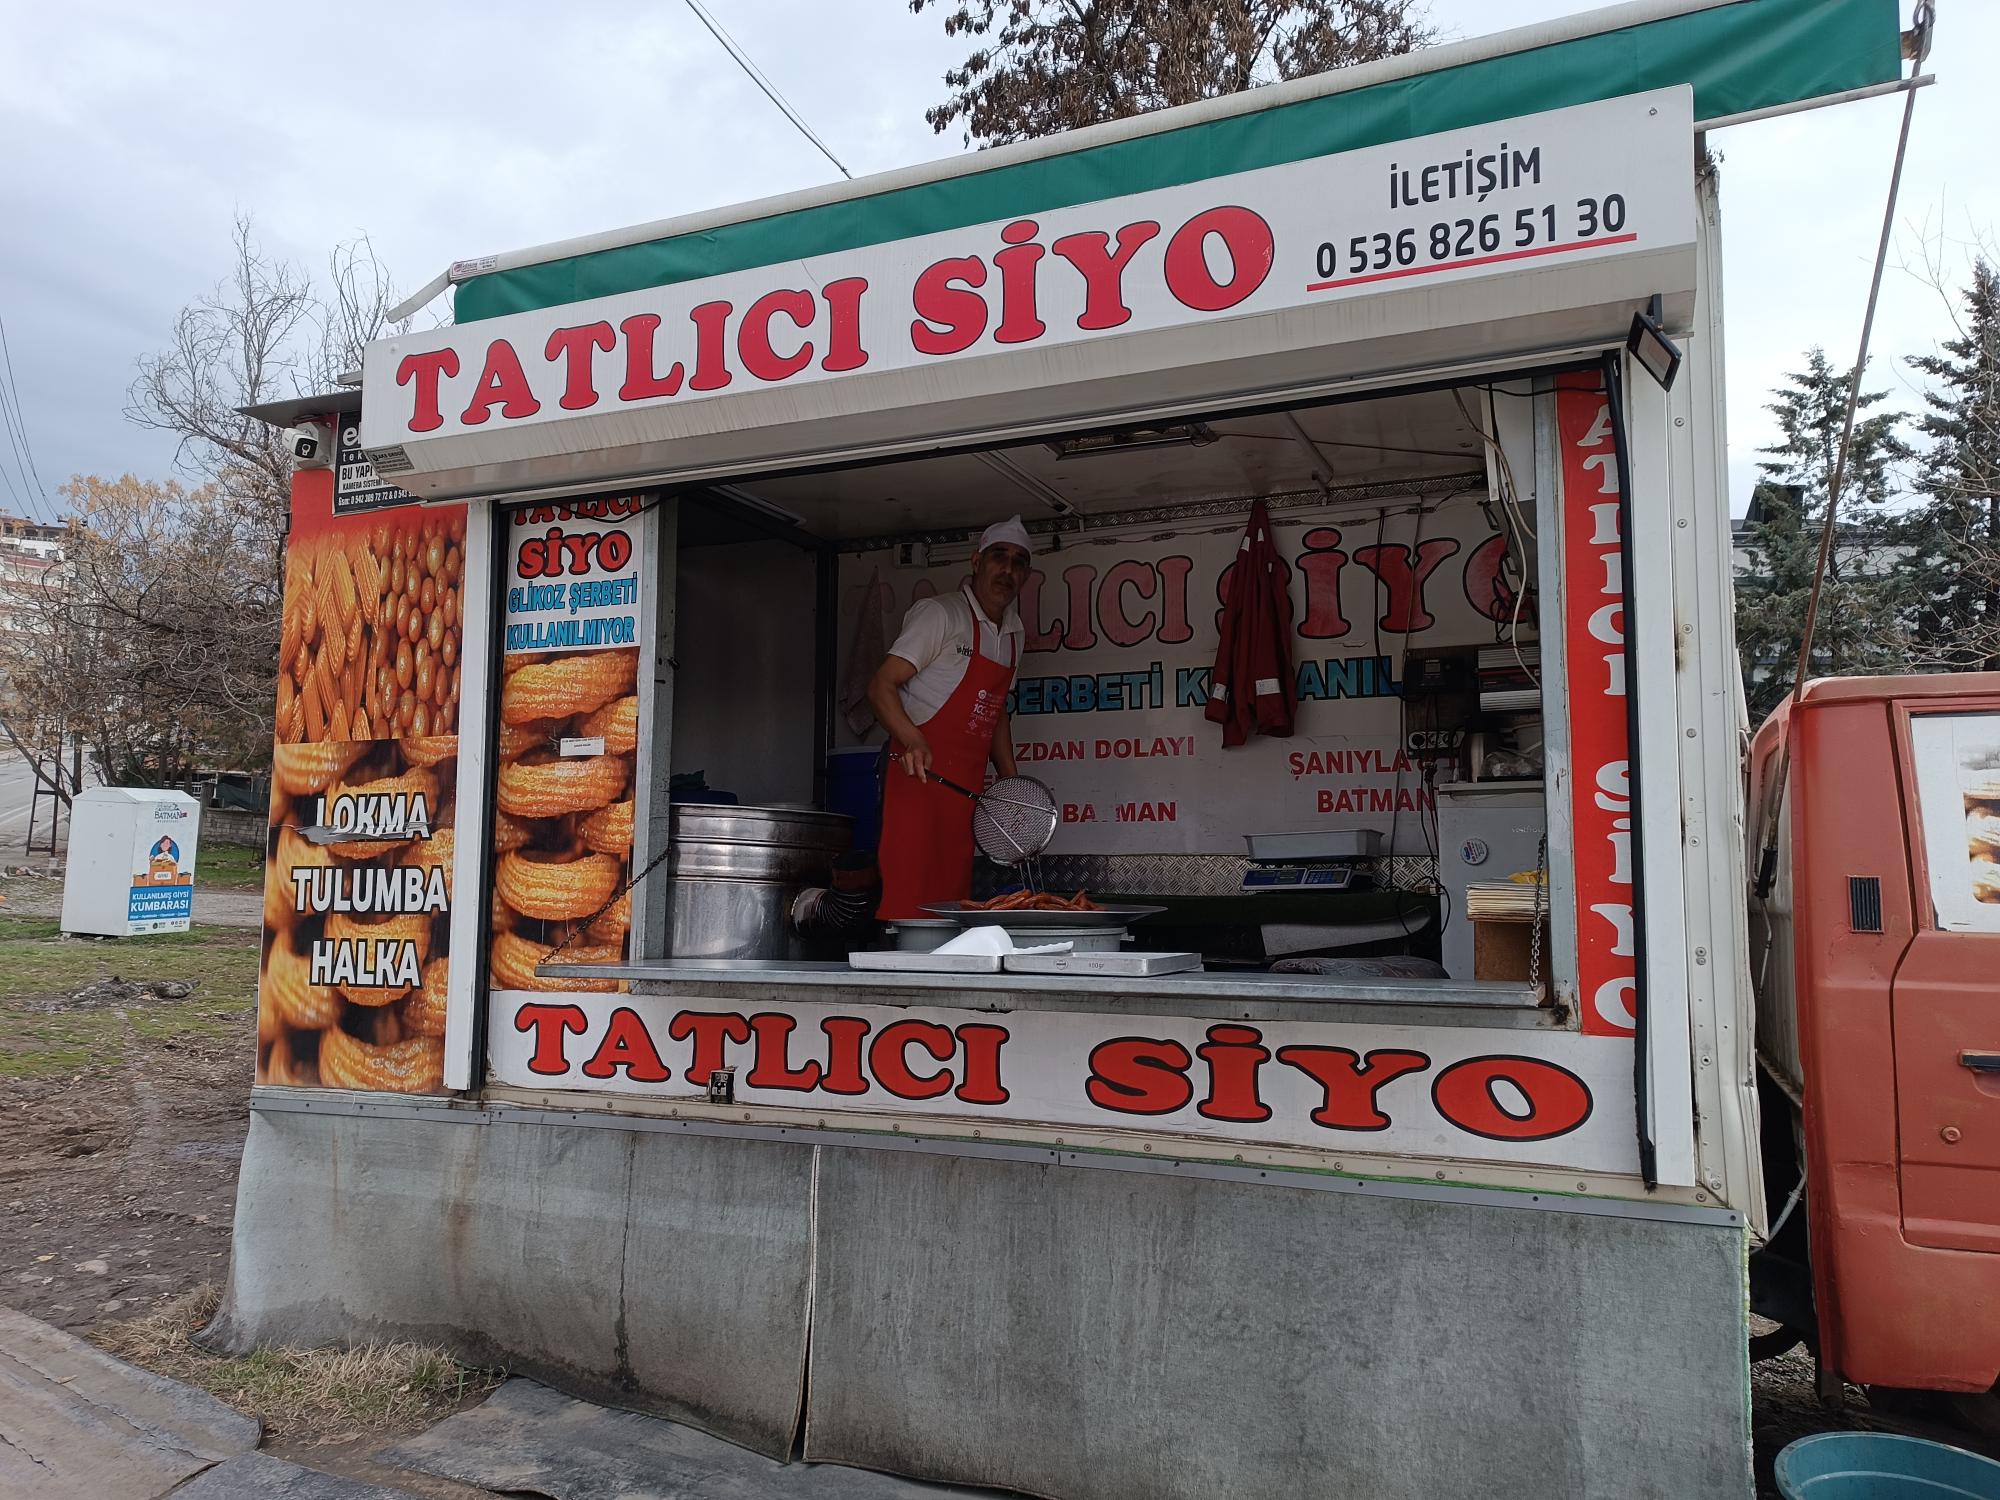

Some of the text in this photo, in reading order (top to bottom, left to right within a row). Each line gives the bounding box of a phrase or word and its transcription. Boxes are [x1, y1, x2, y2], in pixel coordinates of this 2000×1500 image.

[1390, 142, 1540, 208] İLETİŞİM
[1316, 193, 1626, 278] 0 536 826 51 30
[396, 205, 1275, 433] TATLICI SİYO
[342, 466, 353, 480] BU
[355, 464, 373, 478] YAPI
[342, 481, 362, 491] KAMERA
[517, 527, 633, 579] SİYO
[508, 571, 637, 615] GLİKOZ ŞERBETİ
[506, 615, 635, 650] KULLANILMIYOR
[1094, 736, 1194, 760] DOLAYI
[130, 900, 189, 912] KUMBARASI
[290, 865, 449, 914] TULUMBA
[308, 938, 424, 990] HALKA
[514, 1001, 1594, 1142] TATLICI SİYO
